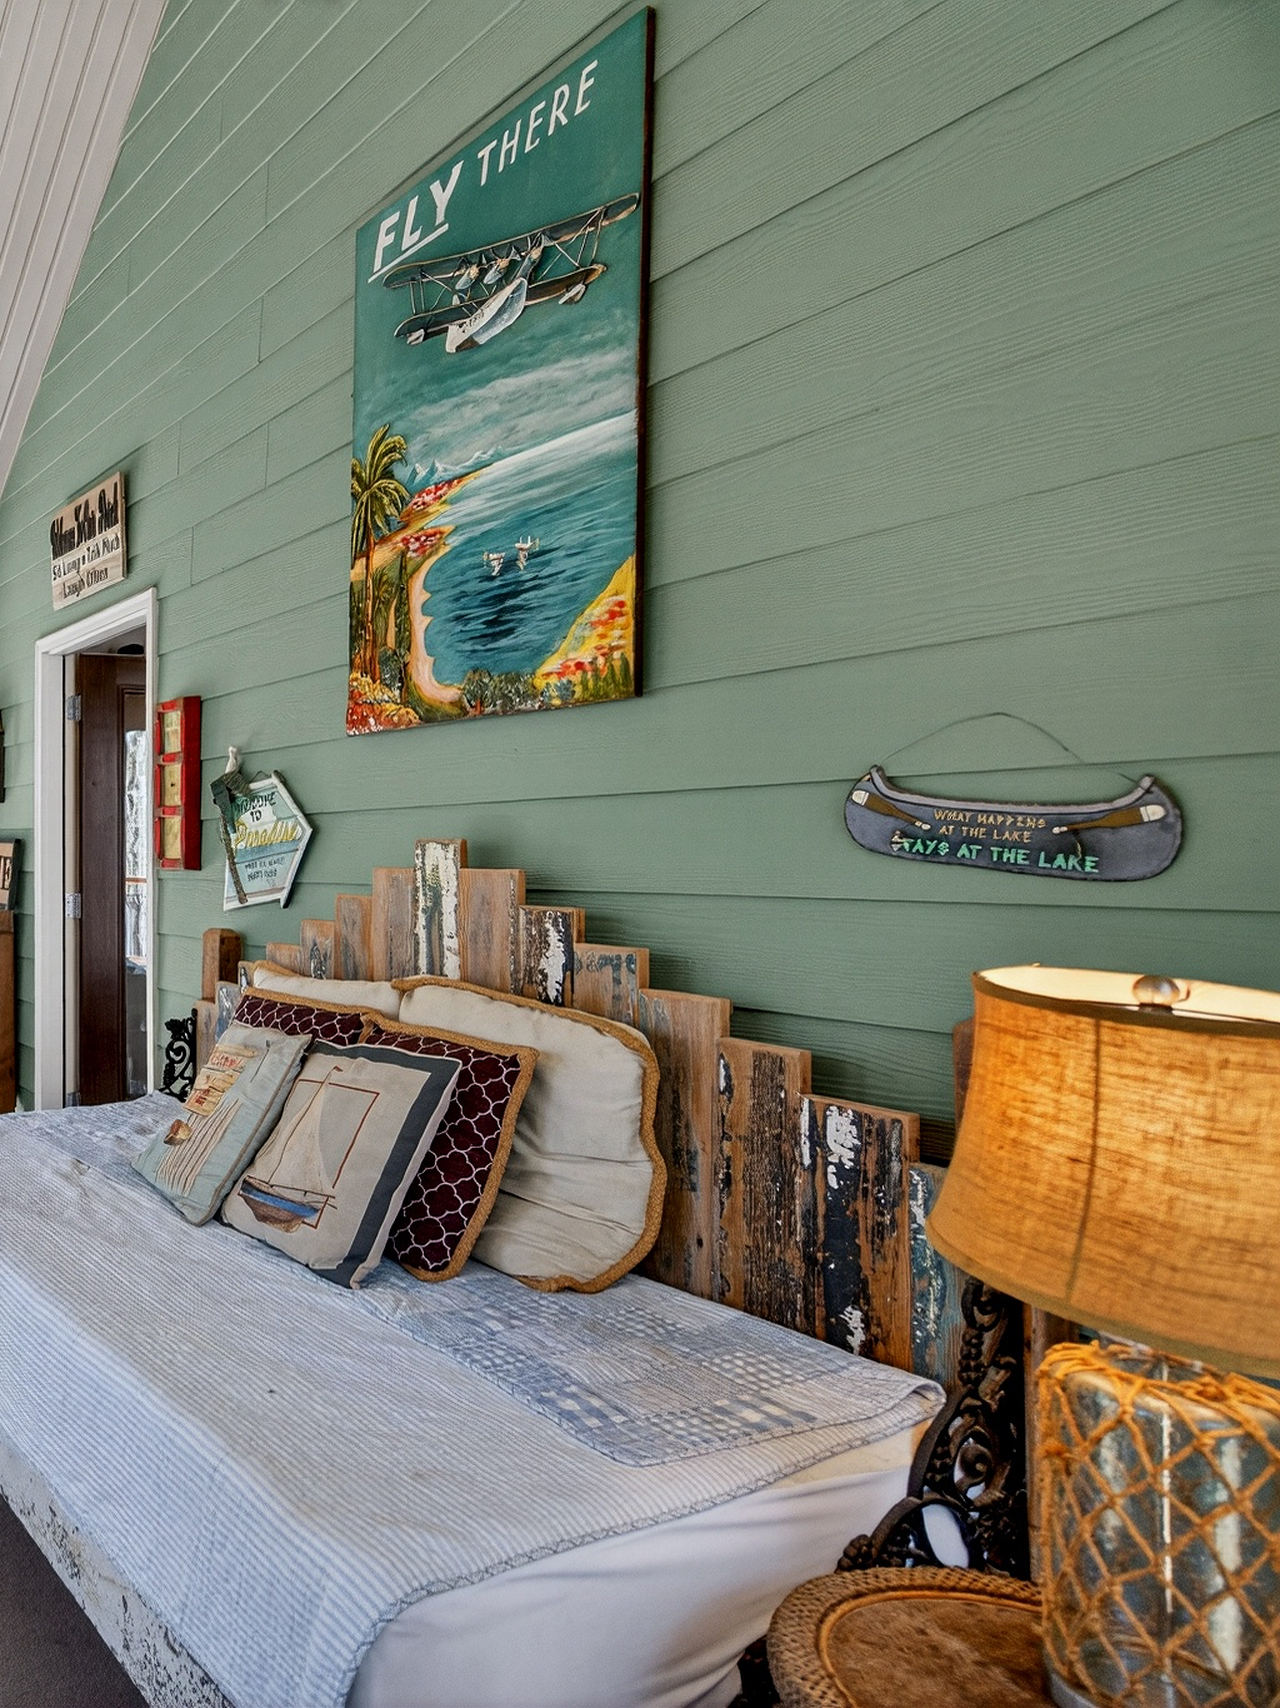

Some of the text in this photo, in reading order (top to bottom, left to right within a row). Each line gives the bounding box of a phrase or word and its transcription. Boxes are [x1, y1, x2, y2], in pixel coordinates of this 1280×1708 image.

[372, 59, 598, 273] FLY THERE
[933, 808, 973, 823] WHAT
[939, 824, 1032, 844] AT THE LAKE
[892, 838, 1100, 873] TAYS AT THE LAKE
